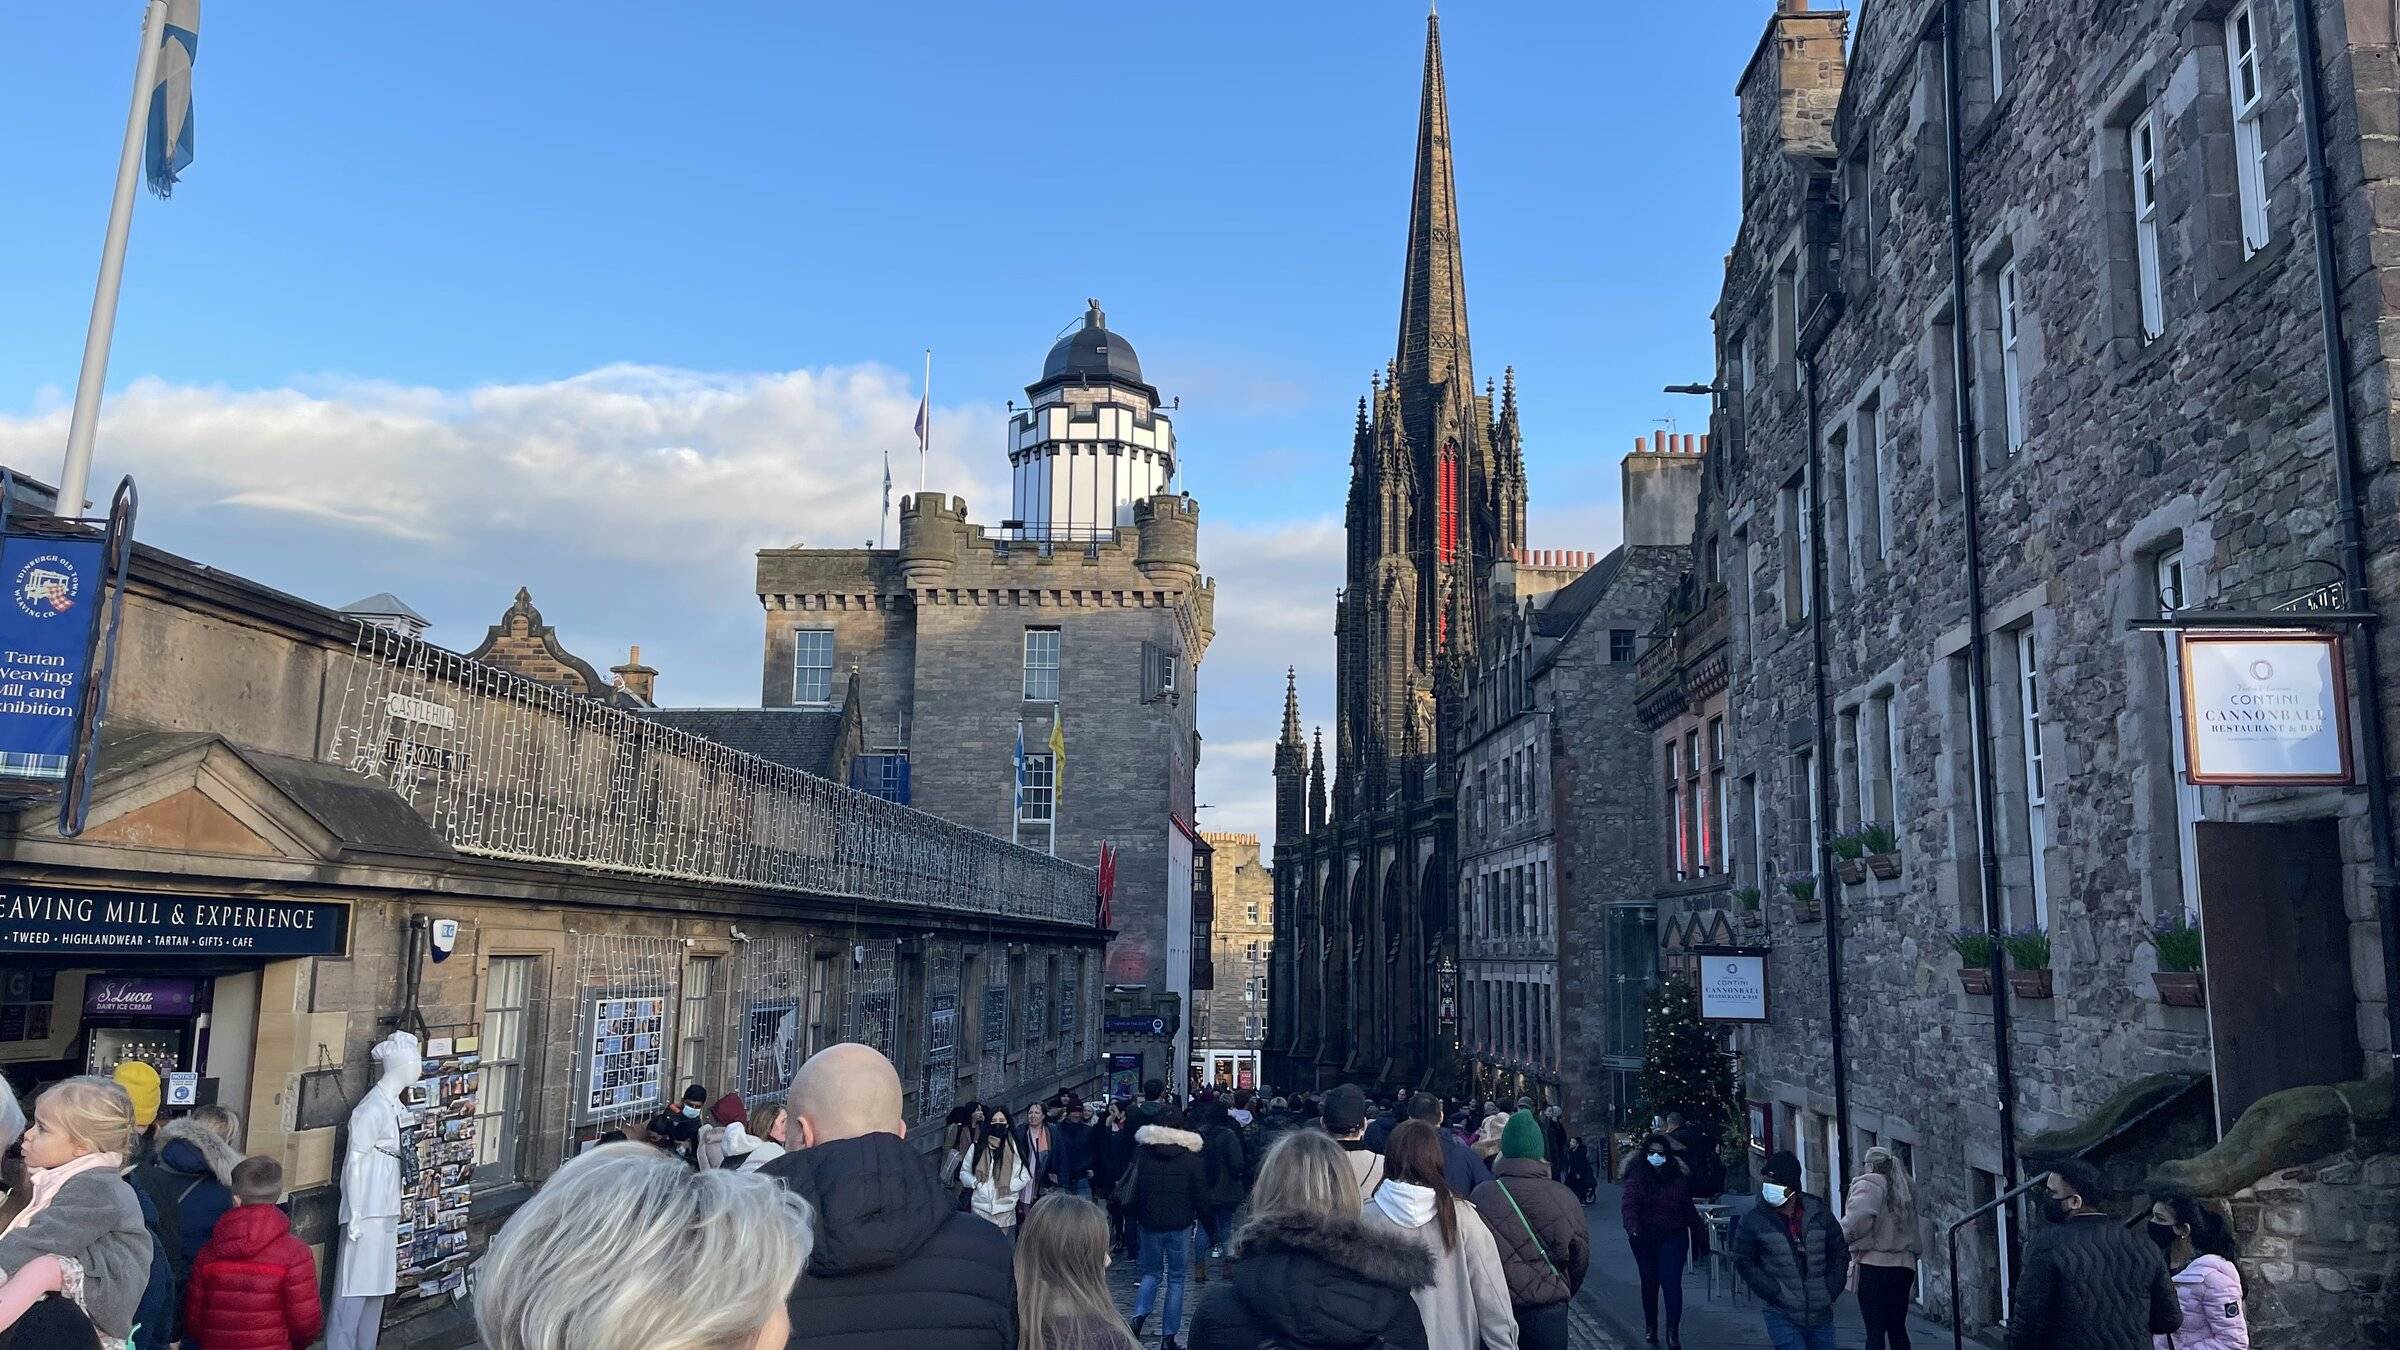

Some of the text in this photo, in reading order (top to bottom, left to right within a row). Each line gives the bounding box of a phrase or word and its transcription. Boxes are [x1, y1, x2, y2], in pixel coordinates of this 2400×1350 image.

[16, 555, 79, 597] EDINBURGH OLD TOWN
[14, 589, 41, 618] WEAVING
[5, 651, 65, 667] Tartan
[28, 687, 66, 700] and
[2230, 694, 2299, 706] CONTINI
[2205, 710, 2327, 721] CANNONBALL
[2211, 724, 2284, 733] RESTAURANT
[2301, 724, 2323, 733] BAR
[105, 900, 160, 924] MILL
[171, 903, 185, 925] &
[195, 904, 315, 929] EXPERIENCE
[13, 931, 253, 947] TWEED HIGHLANDWEAR TARTAN GIFTS CAFE
[96, 1003, 116, 1011] DAIRY
[128, 1003, 153, 1011] CREAM
